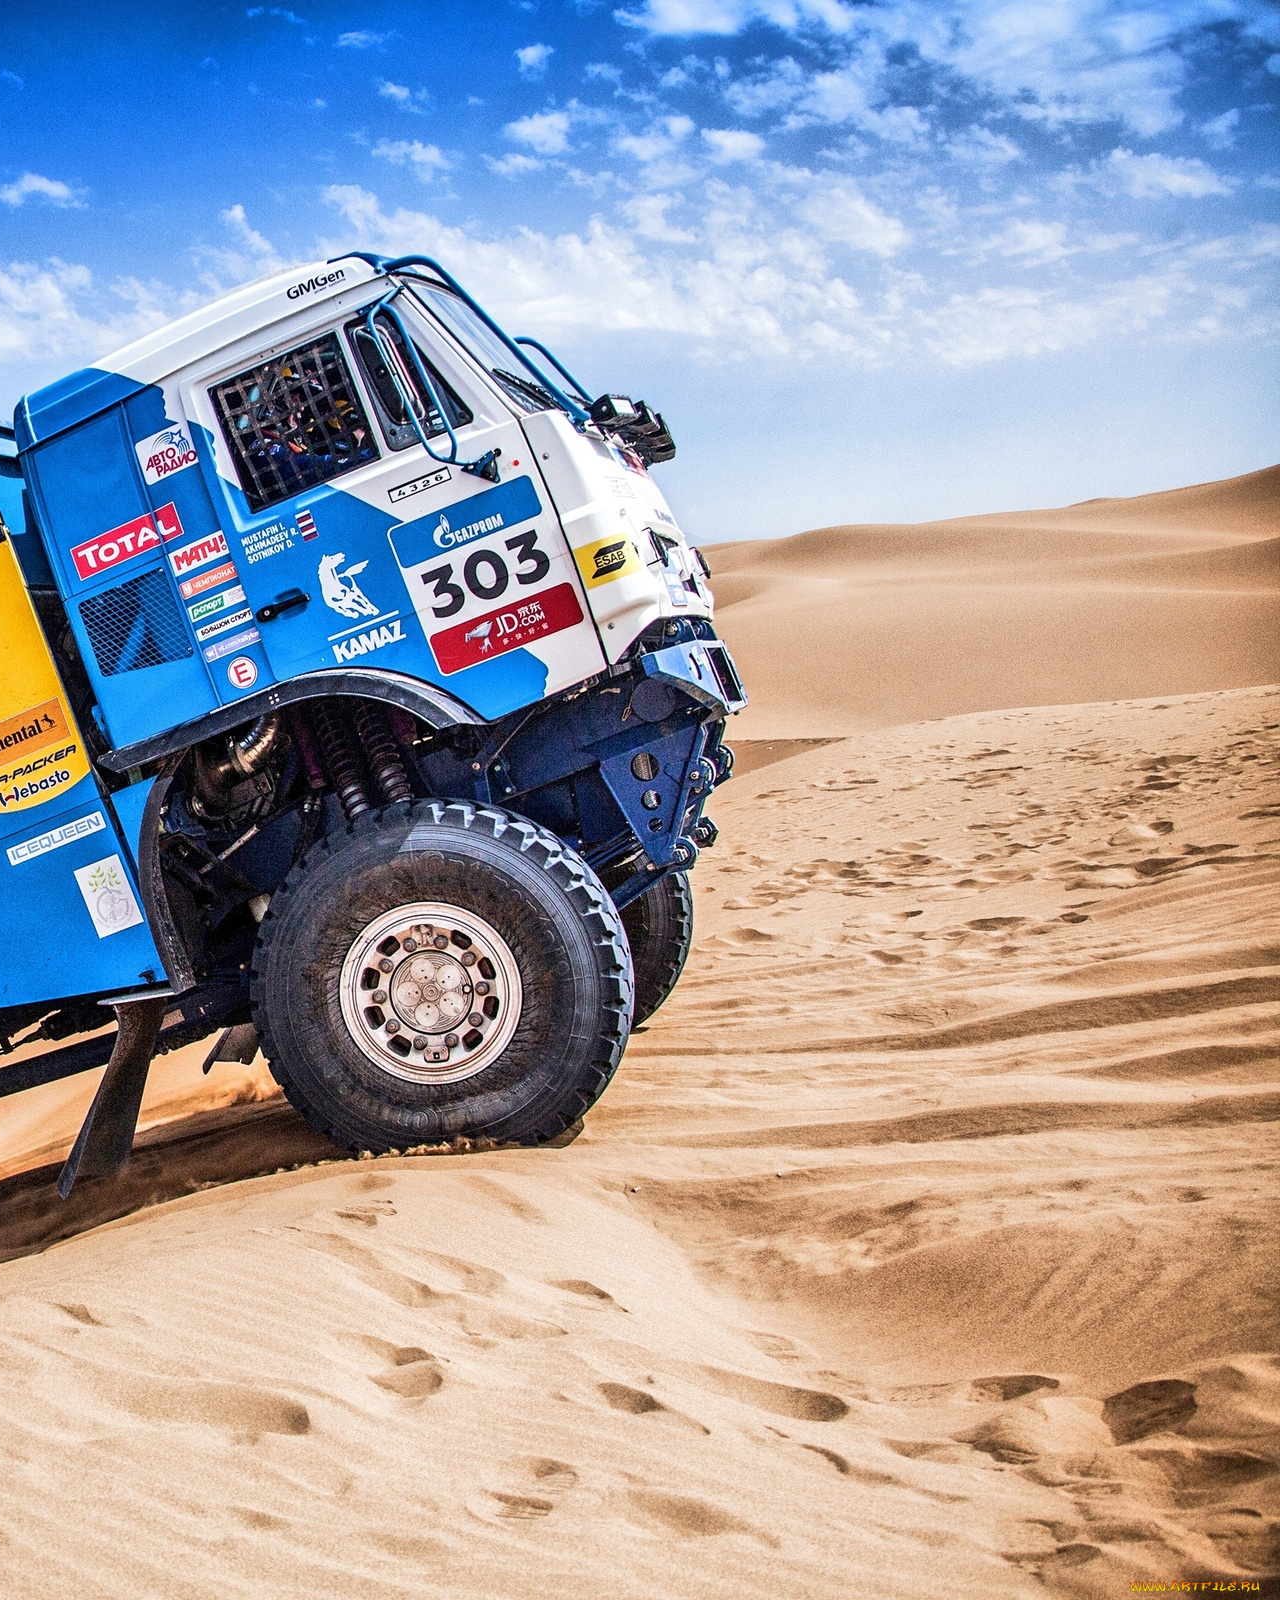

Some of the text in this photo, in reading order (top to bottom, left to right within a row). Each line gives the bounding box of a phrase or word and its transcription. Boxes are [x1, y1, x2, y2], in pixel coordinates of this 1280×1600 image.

[286, 269, 345, 300] GMGen
[146, 447, 176, 472] АВТО
[155, 450, 198, 478] РАДИО
[397, 473, 444, 498] 4326
[240, 525, 279, 548] MUSTAFIN
[244, 527, 299, 556] AKHMADEEV R.
[453, 513, 505, 544] GAZPROM
[78, 519, 177, 569] TOTAL
[246, 539, 296, 565] SOTNIKOV D.
[594, 550, 626, 569] ESAB
[192, 566, 236, 590] ЧЕМПИОНАТ
[421, 529, 550, 619] 303
[231, 609, 252, 623] СПОРТ
[516, 601, 542, 618] 京东
[332, 620, 407, 664] KAMAZ
[234, 662, 252, 684] E
[10, 815, 102, 861] ICEQUEEN
